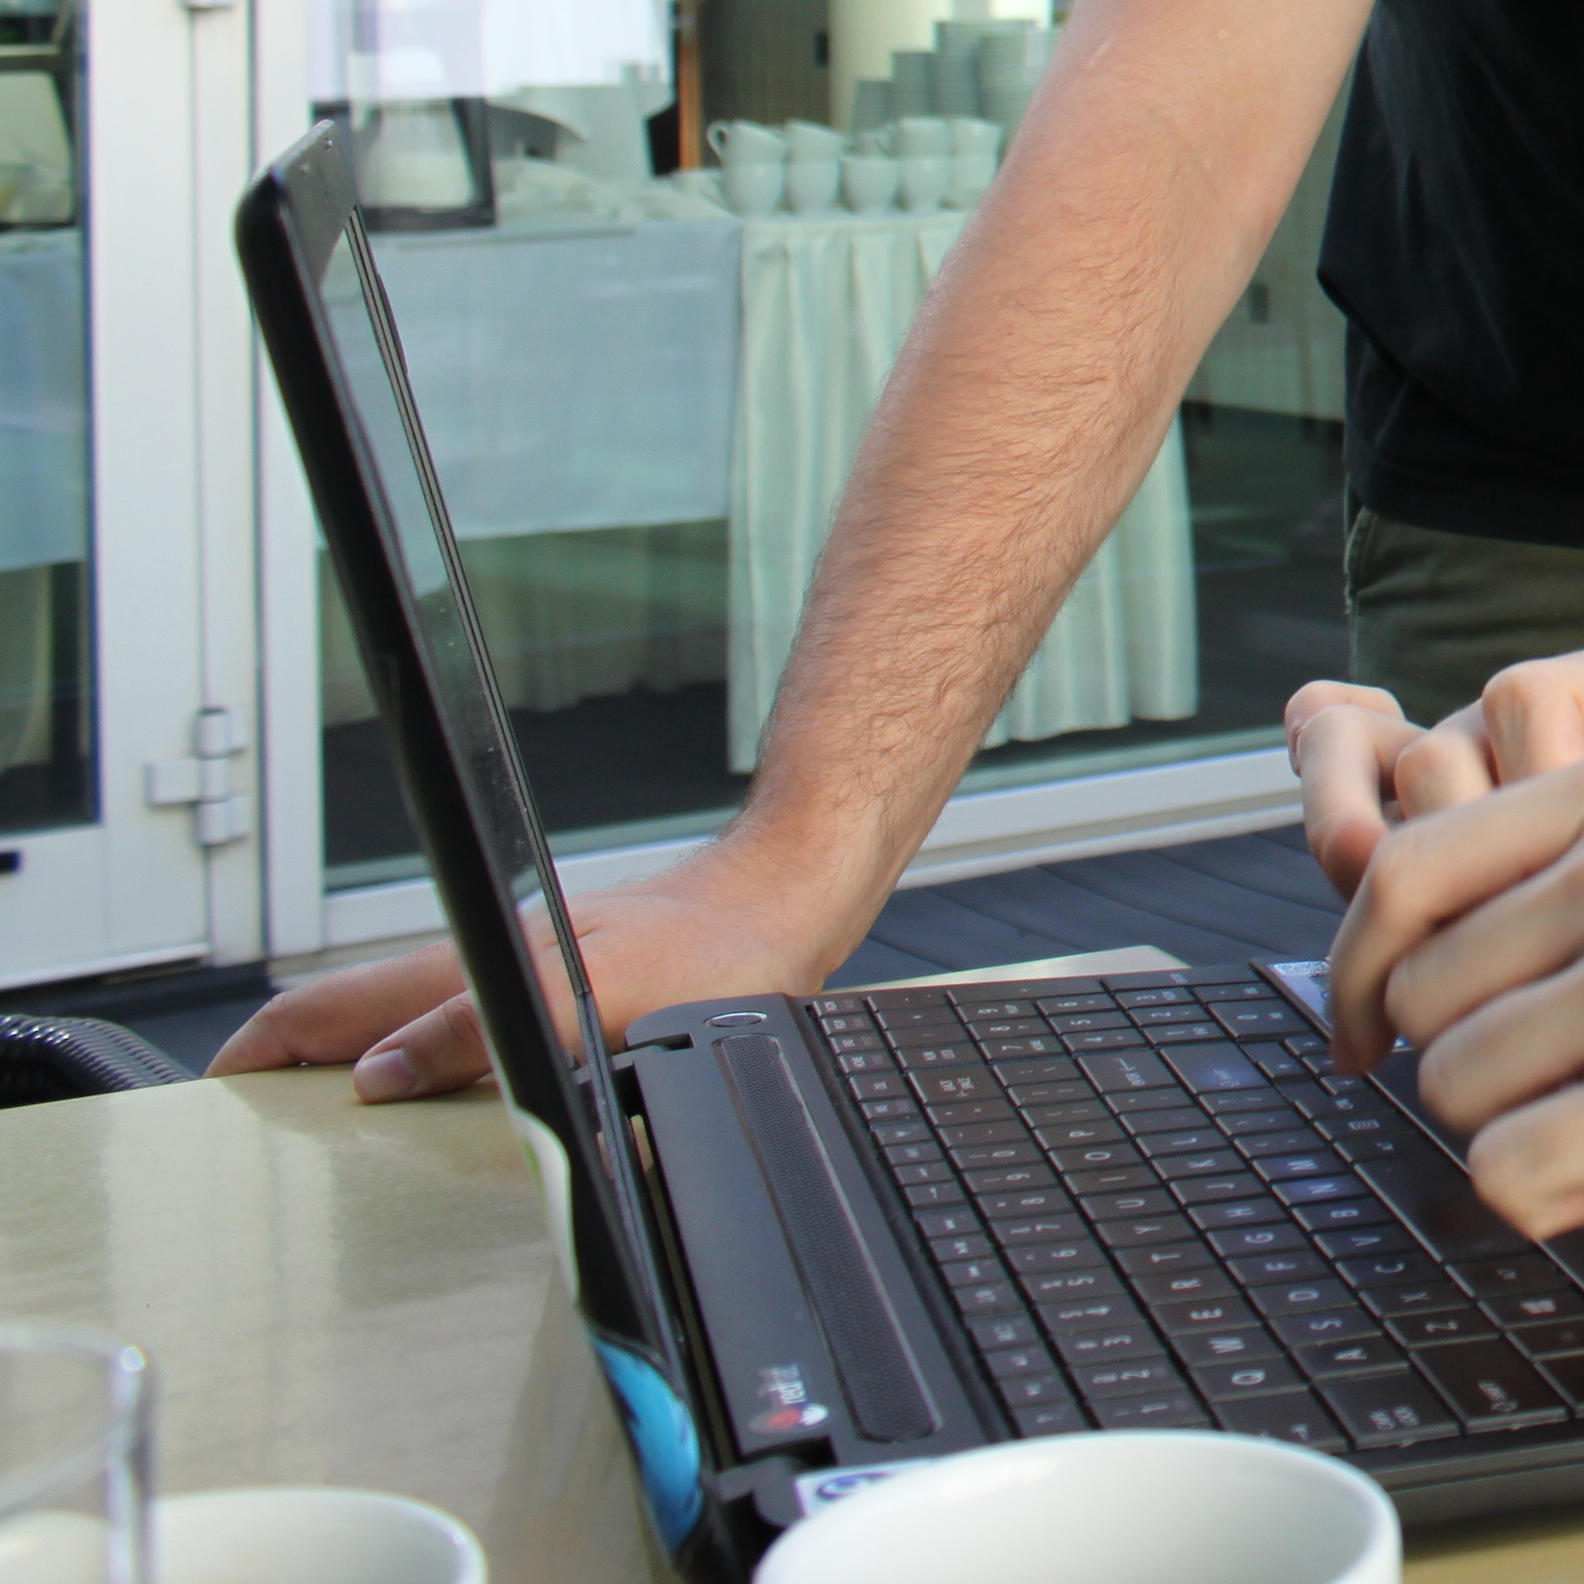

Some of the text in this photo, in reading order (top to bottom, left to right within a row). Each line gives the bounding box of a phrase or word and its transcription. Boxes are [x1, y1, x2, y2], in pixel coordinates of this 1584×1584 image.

[1068, 1129, 1096, 1139] P
[1171, 1136, 1198, 1146] L
[1187, 1158, 1218, 1170] K
[1286, 1159, 1320, 1172] M
[1205, 1182, 1236, 1190] J
[1307, 1182, 1339, 1195] N
[1115, 1198, 1146, 1210] U
[1223, 1206, 1257, 1218] H
[1329, 1208, 1361, 1219] B
[1133, 1225, 1162, 1235] Y
[1243, 1231, 1277, 1245] G
[1350, 1235, 1382, 1247] V
[1050, 1249, 1078, 1259] 6
[1150, 1252, 1182, 1263] T
[1264, 1261, 1297, 1272] F
[1373, 1261, 1406, 1274] C
[1066, 1276, 1095, 1287] 5
[1170, 1278, 1203, 1291] R
[1287, 1287, 1321, 1302] D
[1399, 1291, 1431, 1303] X
[1189, 1307, 1224, 1321] E
[1308, 1317, 1344, 1331] S
[1425, 1318, 1460, 1332] Z
[1102, 1335, 1132, 1347] 3
[1207, 1336, 1247, 1355] W
[1333, 1346, 1369, 1362] A
[1120, 1368, 1151, 1381] 2
[1230, 1369, 1267, 1387] Q
